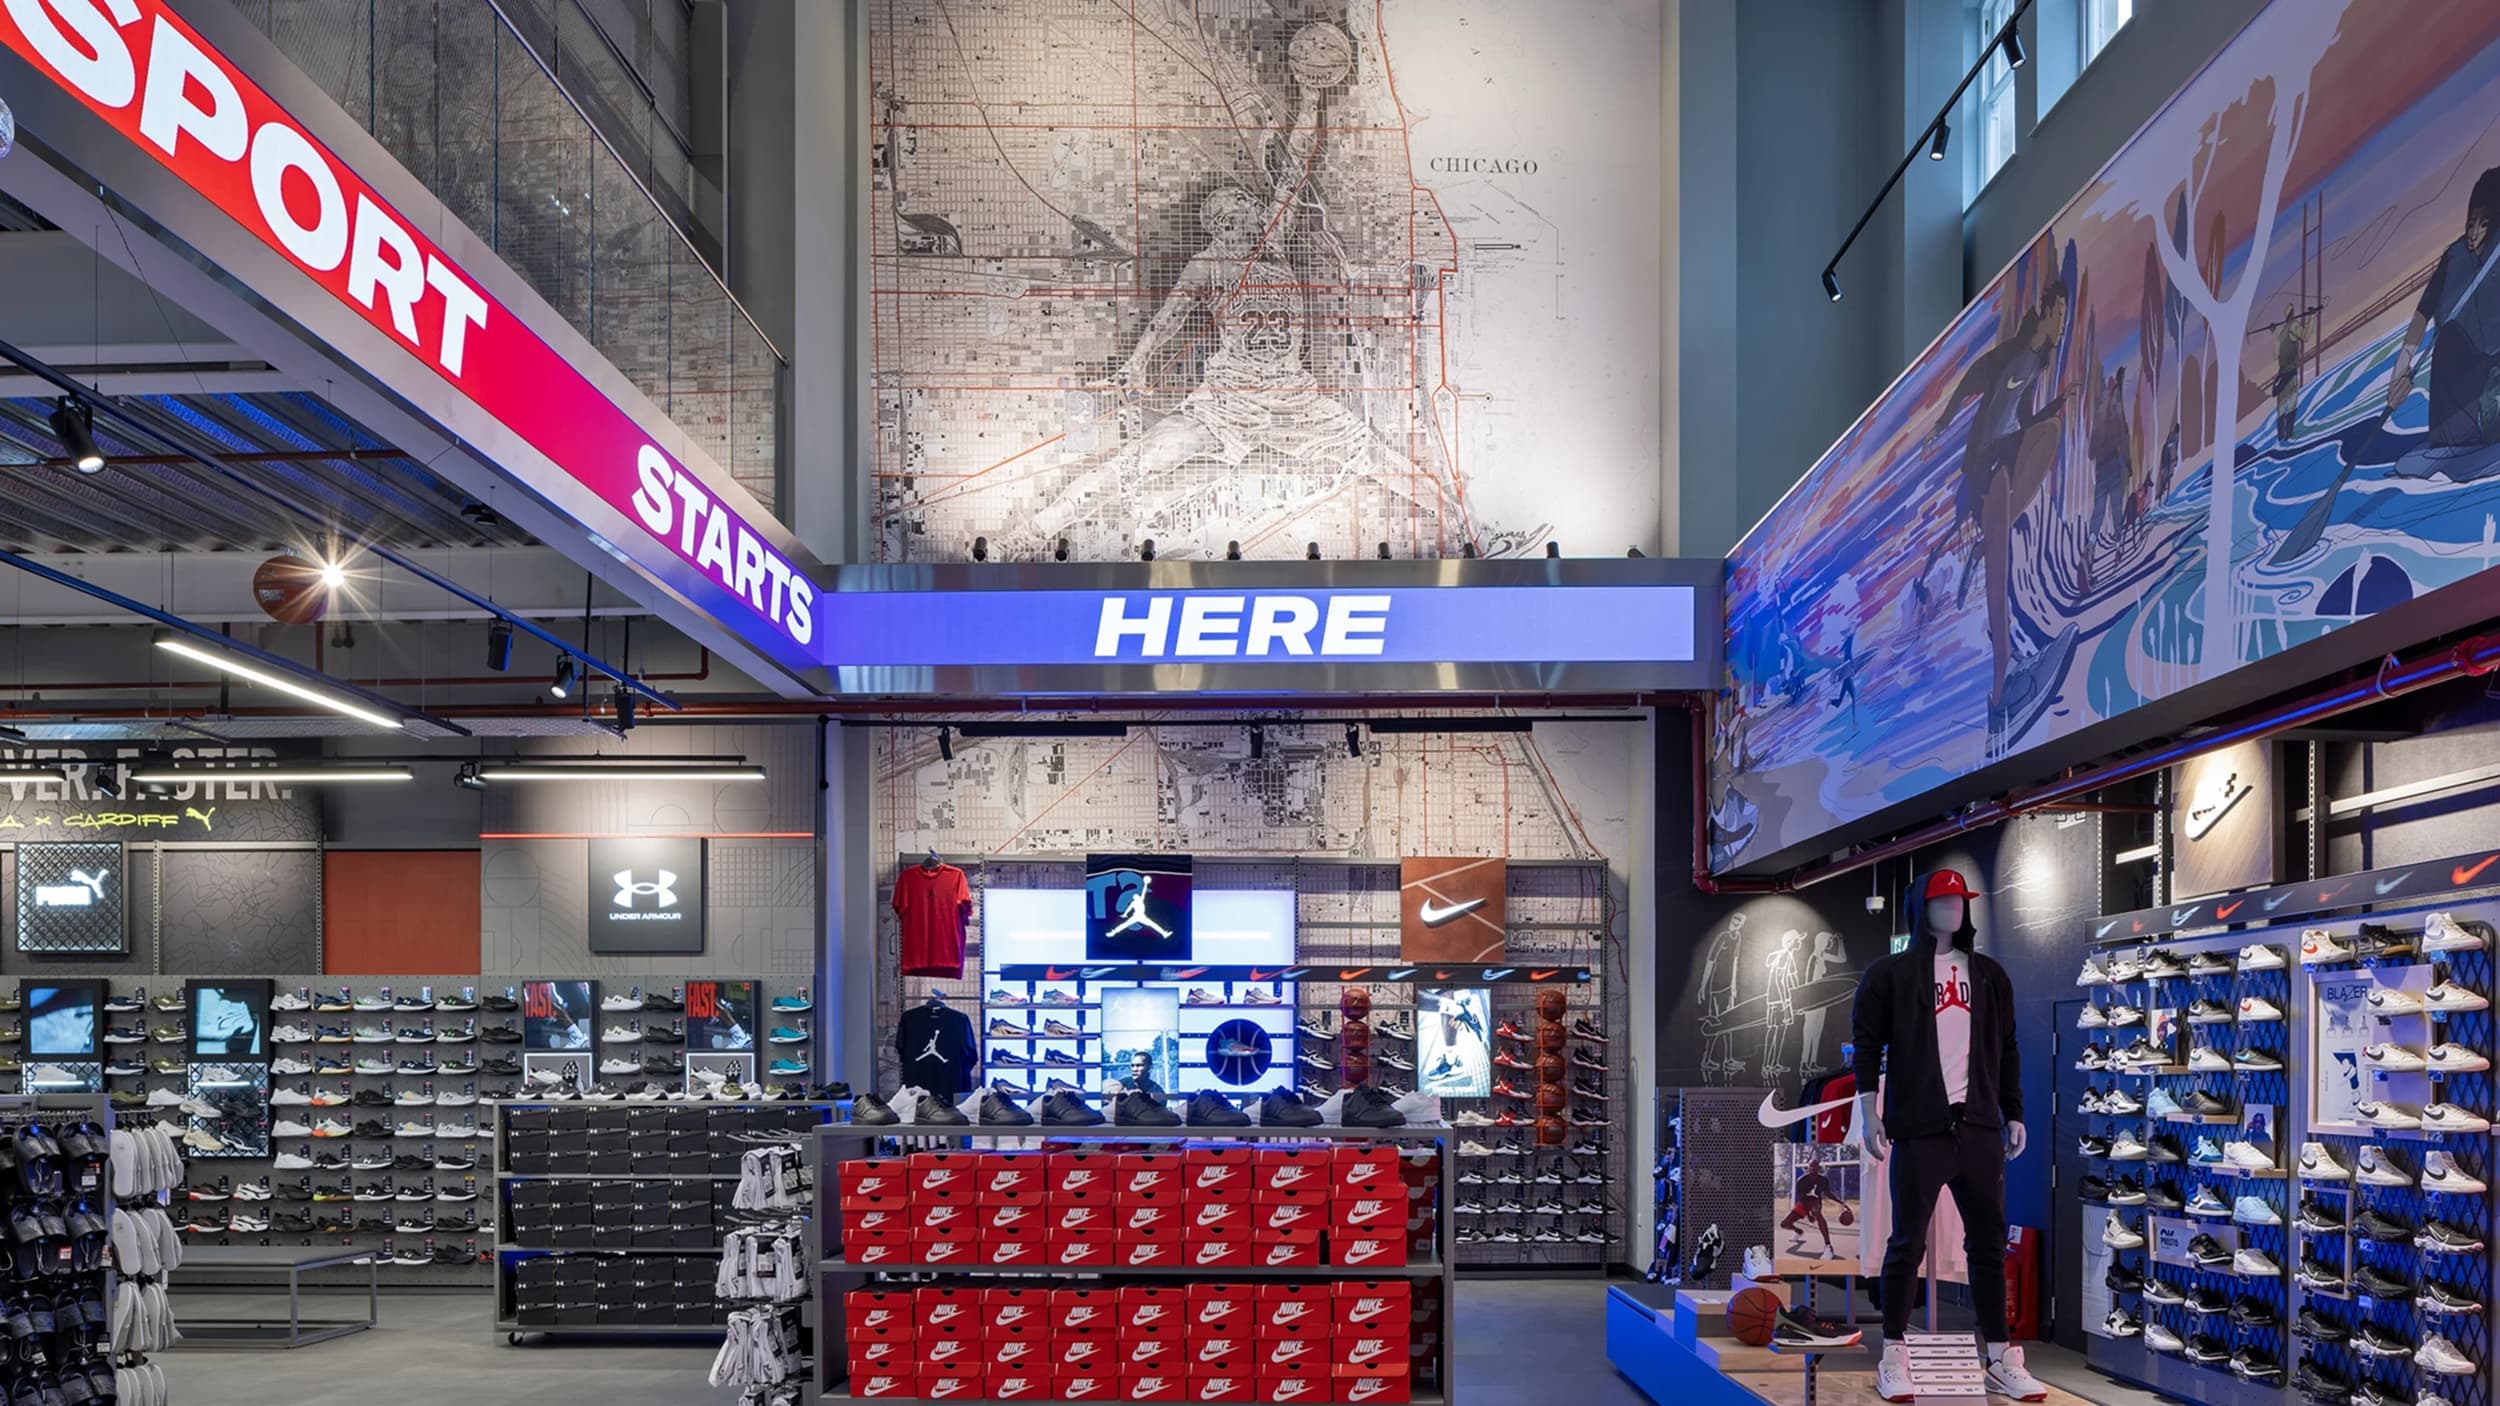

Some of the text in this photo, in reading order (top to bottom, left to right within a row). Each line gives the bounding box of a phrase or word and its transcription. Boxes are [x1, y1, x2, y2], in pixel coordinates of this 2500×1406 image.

[1430, 157, 1539, 175] CHICAGO
[5, 0, 1392, 656] SPORT STARTS HERE
[1238, 308, 1295, 353] 23
[0, 748, 102, 801] VER.
[63, 812, 179, 831] CARDIFF
[609, 912, 682, 921] UNDER ARMOUR
[2327, 984, 2368, 1002] BLAZER
[687, 982, 720, 1018] FAST.
[928, 1169, 950, 1180] NIKE
[1203, 1165, 1228, 1178] NIKE
[1277, 1165, 1302, 1178] NIKE
[1352, 1163, 1375, 1175] NIKE
[862, 1177, 882, 1187] NIKE
[996, 1170, 1019, 1182] NIKE
[1068, 1170, 1091, 1182] NIKE
[1135, 1171, 1158, 1183] NIKE
[930, 1206, 952, 1217] NIKE
[998, 1206, 1021, 1218] NIKE
[1203, 1203, 1228, 1216] NIKE
[1275, 1205, 1300, 1218] NIKE
[1354, 1200, 1382, 1214] NIKE
[865, 1212, 883, 1222] NIKE
[1067, 1207, 1092, 1220] NIKE
[1135, 1208, 1158, 1220] NIKE
[866, 1246, 884, 1256] NIKE
[931, 1242, 954, 1254] NIKE
[998, 1243, 1020, 1254] NIKE
[1066, 1243, 1089, 1255] NIKE
[1134, 1244, 1157, 1256] NIKE
[1203, 1242, 1228, 1255] NIKE
[1272, 1245, 1295, 1257] NIKE
[1351, 1240, 1379, 1254] NIKE
[935, 1304, 957, 1315] NIKE
[1138, 1305, 1161, 1317] NIKE
[1206, 1300, 1231, 1313] NIKE
[1279, 1302, 1304, 1315] NIKE
[1356, 1298, 1384, 1312] NIKE
[869, 1310, 887, 1320] NIKE
[1001, 1306, 1023, 1317] NIKE
[1070, 1306, 1093, 1318] NIKE
[870, 1343, 888, 1353] NIKE
[935, 1340, 958, 1352] NIKE
[1003, 1342, 1026, 1354] NIKE
[1070, 1342, 1093, 1354] NIKE
[1137, 1341, 1160, 1353] NIKE
[1206, 1339, 1231, 1352] NIKE
[1278, 1340, 1303, 1353] NIKE
[1355, 1339, 1383, 1353] NIKE
[869, 1376, 892, 1388] NIKE
[936, 1378, 959, 1390] NIKE
[1003, 1378, 1026, 1390] NIKE
[1071, 1378, 1094, 1390] NIKE
[1137, 1377, 1162, 1390] NIKE
[1206, 1378, 1231, 1391] NIKE
[1279, 1379, 1304, 1392] NIKE
[1355, 1378, 1382, 1392] NIKE
